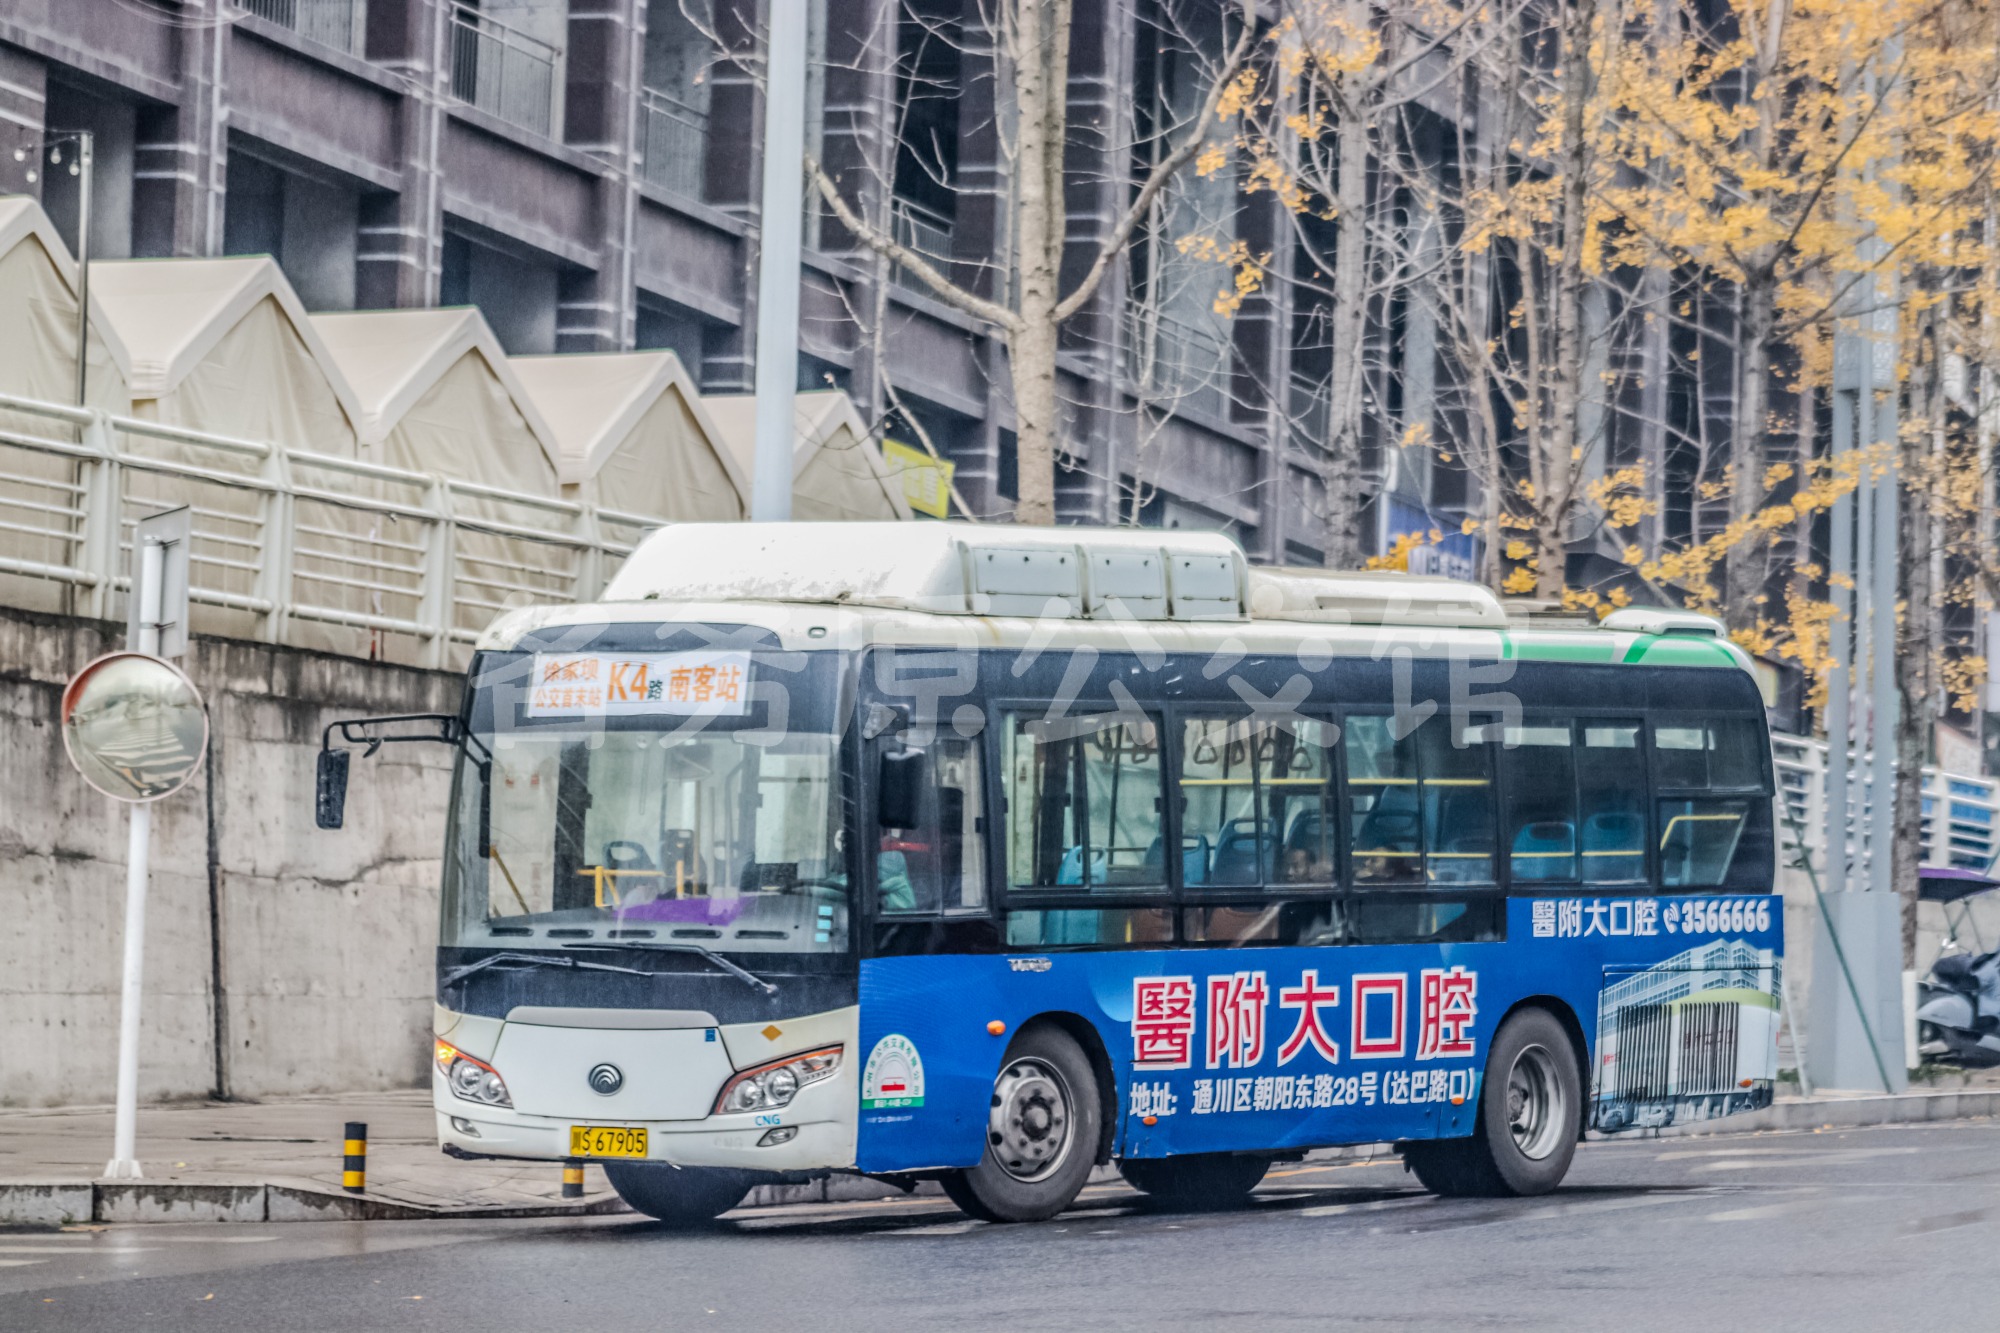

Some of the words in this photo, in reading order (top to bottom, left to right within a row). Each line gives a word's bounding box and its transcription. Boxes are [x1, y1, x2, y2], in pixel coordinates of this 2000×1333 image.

[669, 665, 741, 703] 南客站
[1532, 898, 1658, 937] 醫附大口腔
[1681, 900, 1771, 934] 3566666
[1132, 965, 1479, 1071] 醫附大口腔
[755, 1114, 781, 1126] CNG
